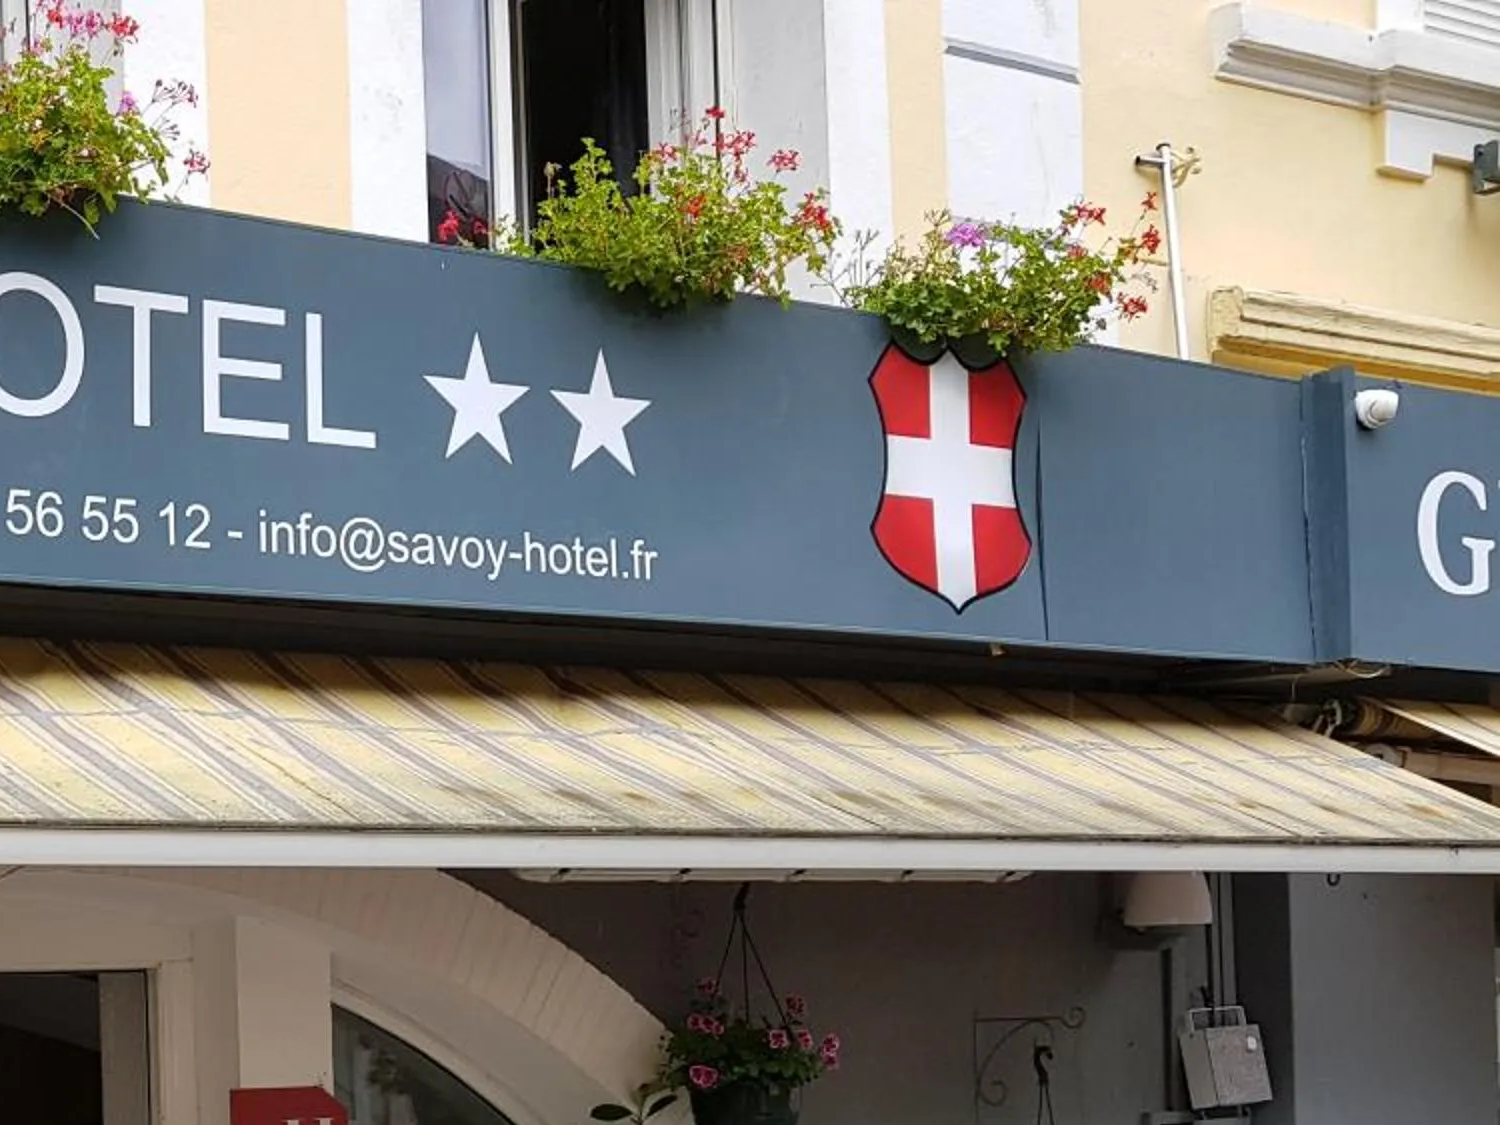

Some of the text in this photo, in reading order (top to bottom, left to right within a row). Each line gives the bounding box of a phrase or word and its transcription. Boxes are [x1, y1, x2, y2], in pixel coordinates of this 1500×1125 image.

[5, 488, 64, 538] 56
[81, 495, 139, 544] 55
[158, 500, 212, 549] 12
[258, 509, 658, 581] info@savoy-hotel.fr
[1417, 471, 1500, 595] G
